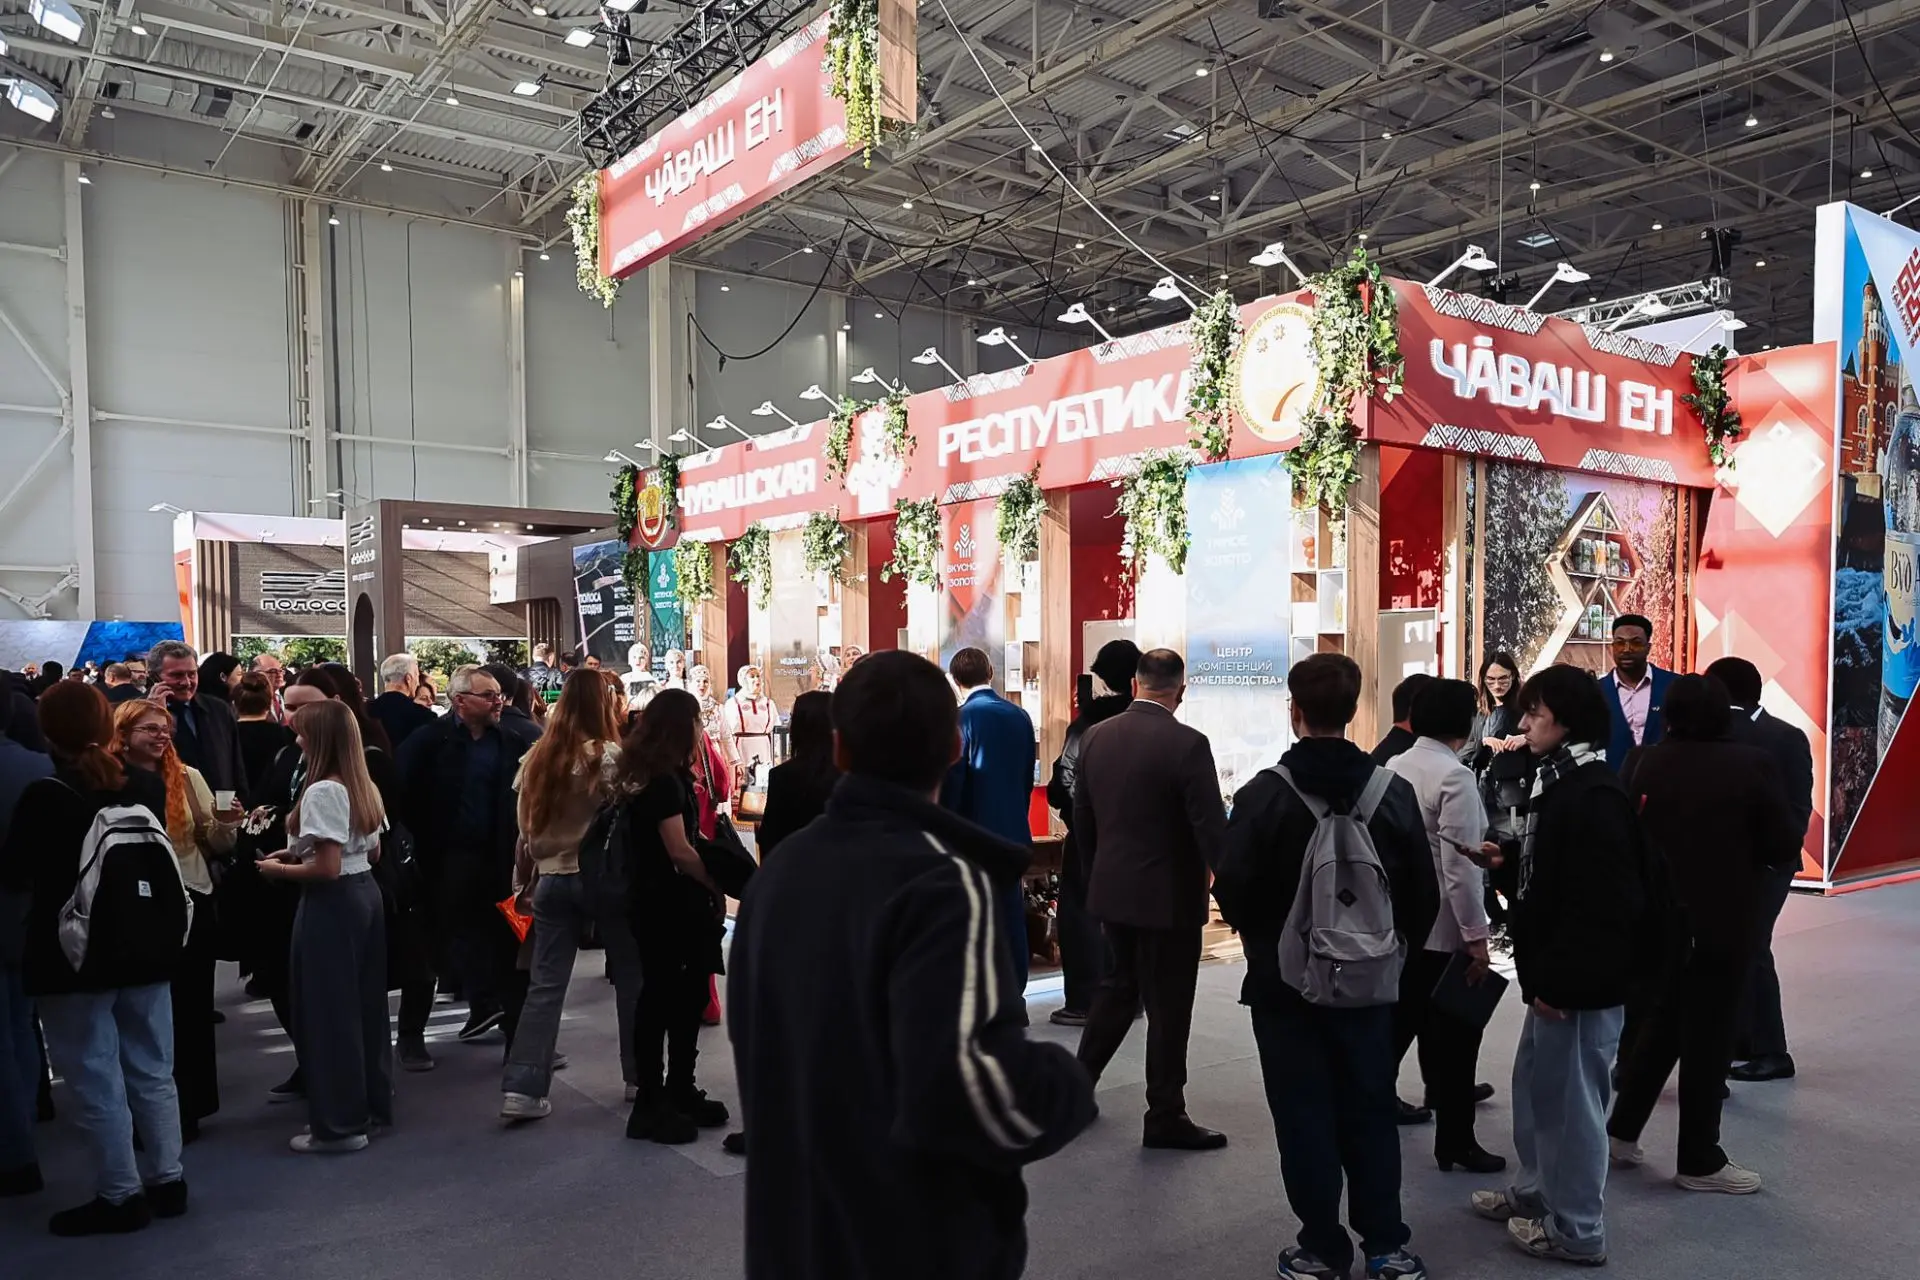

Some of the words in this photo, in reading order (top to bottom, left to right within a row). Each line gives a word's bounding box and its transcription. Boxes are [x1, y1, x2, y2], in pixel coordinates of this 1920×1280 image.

[745, 87, 784, 151] ЕН
[1620, 380, 1674, 435] ЕН
[676, 457, 817, 518] ЧУВАШСКАЯ
[1198, 660, 1273, 672] КОМПЕТЕНЦИЙ
[1216, 647, 1253, 659] ЦЕНТР
[1189, 675, 1283, 686] «ХМЕЛЕВОДСТВА»
